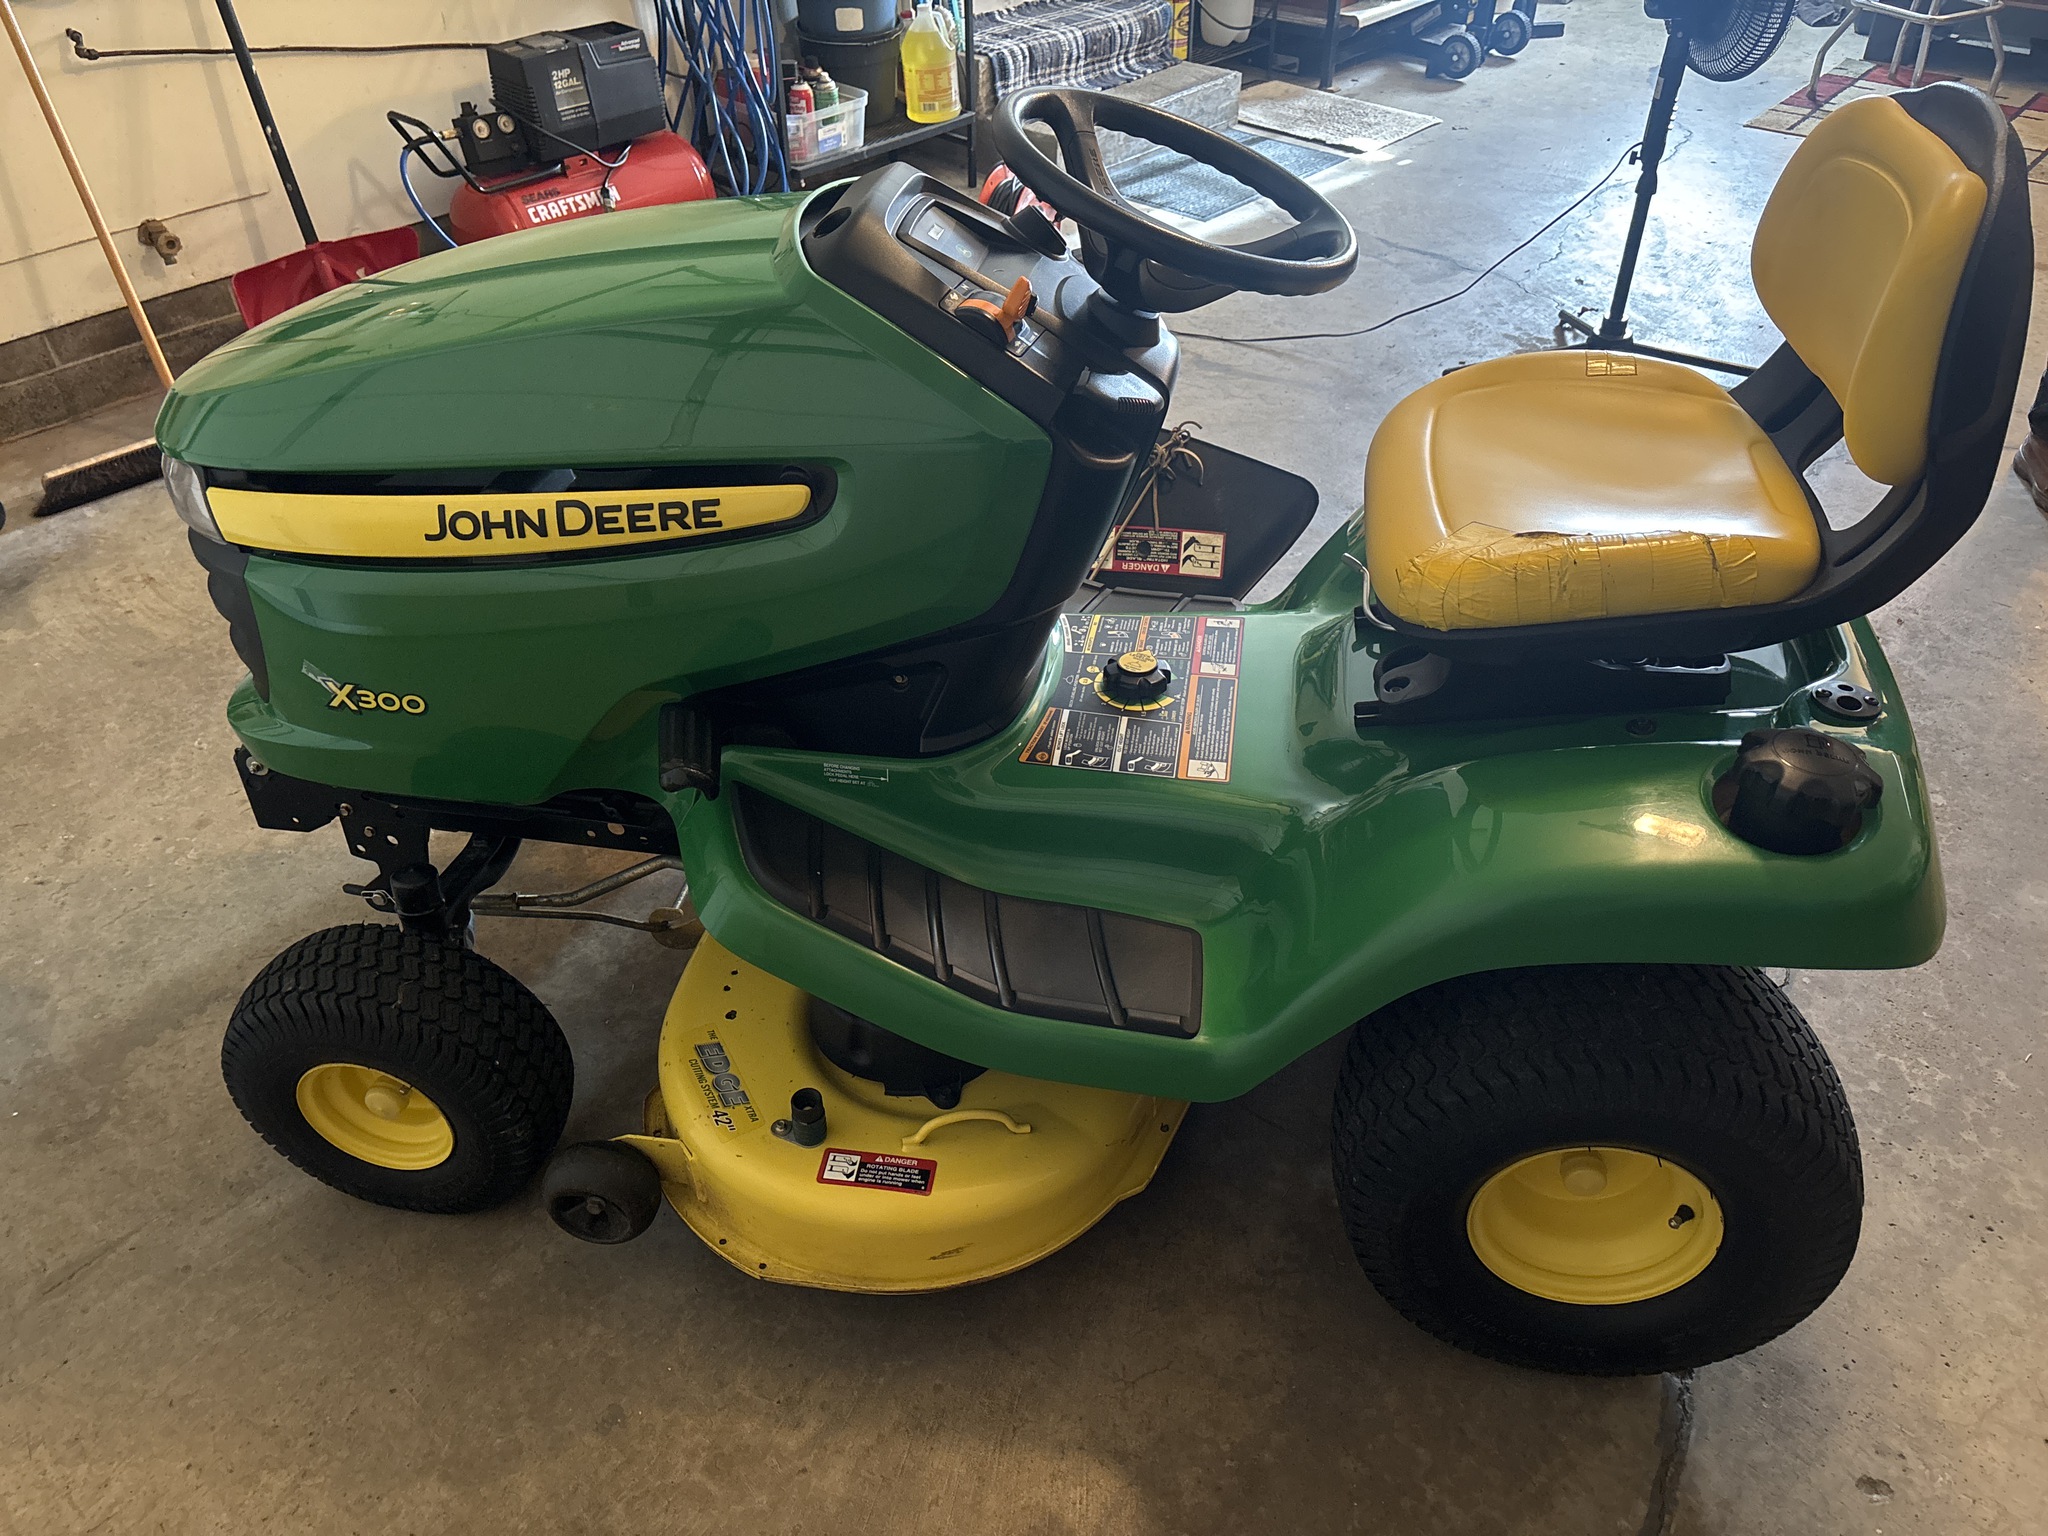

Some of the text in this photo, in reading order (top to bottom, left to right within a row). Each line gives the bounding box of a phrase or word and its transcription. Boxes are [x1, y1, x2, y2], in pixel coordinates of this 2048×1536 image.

[424, 498, 723, 541] JOHN DEERE
[1122, 562, 1160, 572] DANGER
[324, 680, 426, 714] X300
[1185, 711, 1193, 731] WARNING
[688, 1058, 708, 1084] CUTTING
[701, 1082, 720, 1109] SYSTEM
[694, 1029, 759, 1123] THE EDGE XTRA
[866, 1163, 919, 1175] ROTATING BLADE
[884, 1156, 918, 1166] DANGER
[882, 1179, 903, 1187] running
